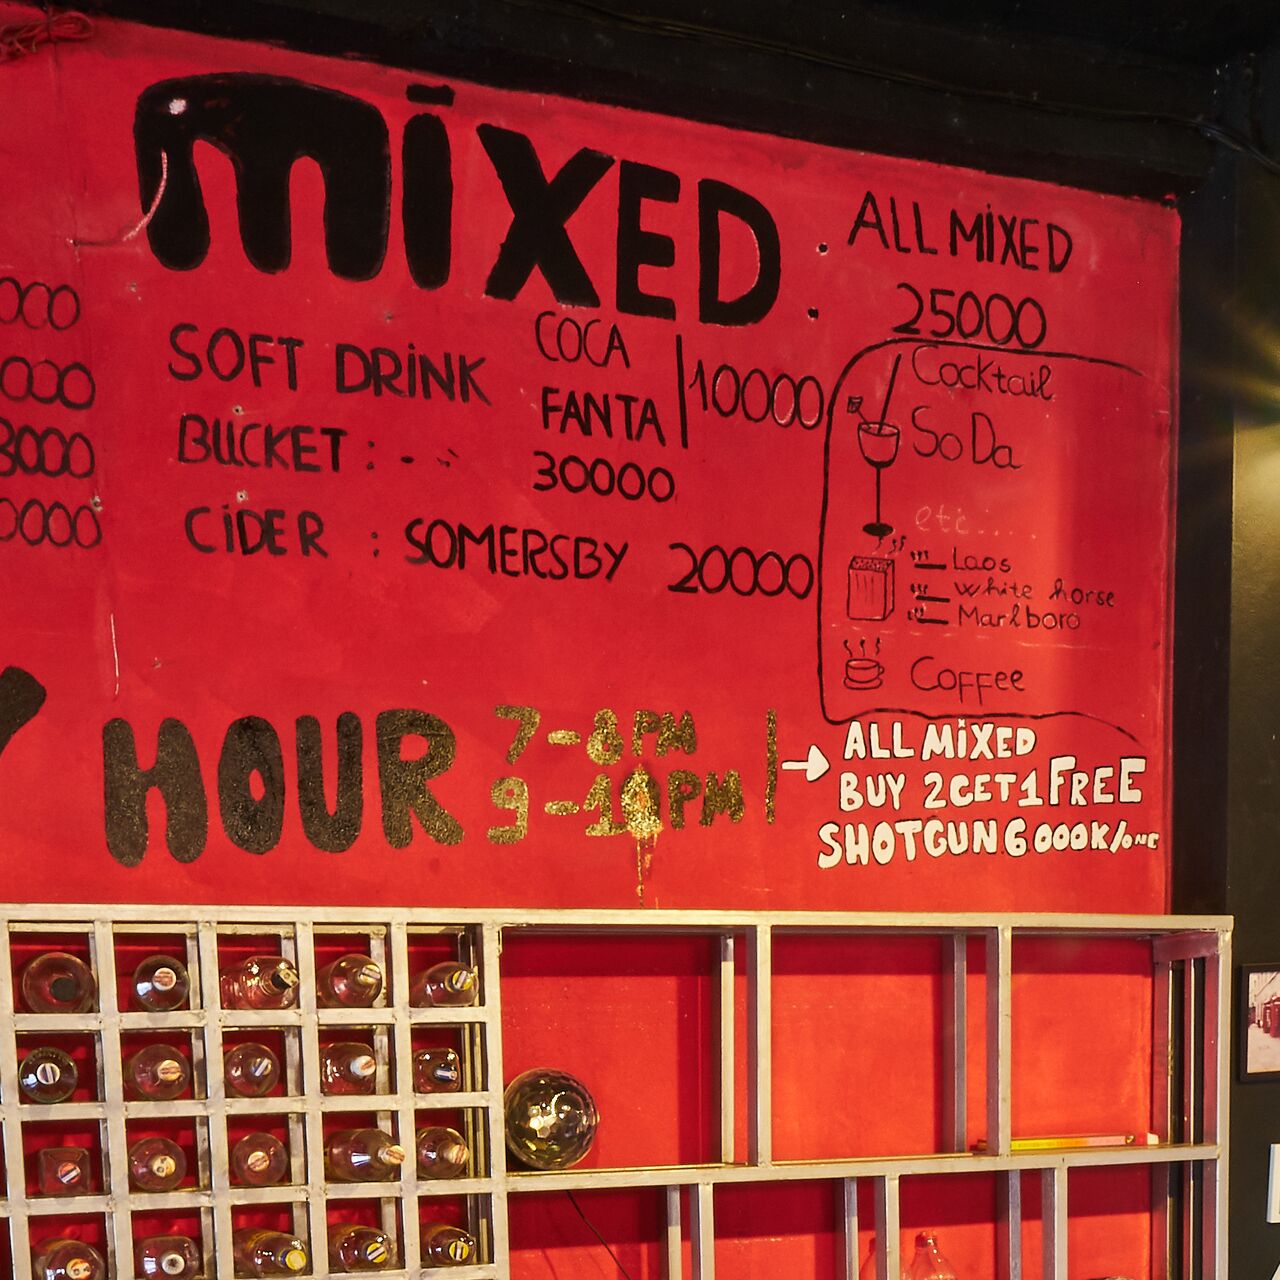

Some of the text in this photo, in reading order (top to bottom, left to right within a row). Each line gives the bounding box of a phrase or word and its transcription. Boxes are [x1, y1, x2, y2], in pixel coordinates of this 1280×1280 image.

[847, 191, 938, 256] ALL
[891, 281, 1048, 350] 25000
[167, 322, 303, 391] SOFT
[533, 309, 631, 369] COCA
[688, 359, 825, 430] 10000
[540, 386, 667, 447] FANTA
[176, 413, 675, 503] BUCKET 30000
[405, 516, 630, 583] SOMERSBY
[667, 541, 815, 600] 20000
[952, 546, 1012, 573] Laos
[843, 719, 915, 761] ALL
[102, 706, 465, 869] HOUR
[839, 771, 907, 812] BUY
